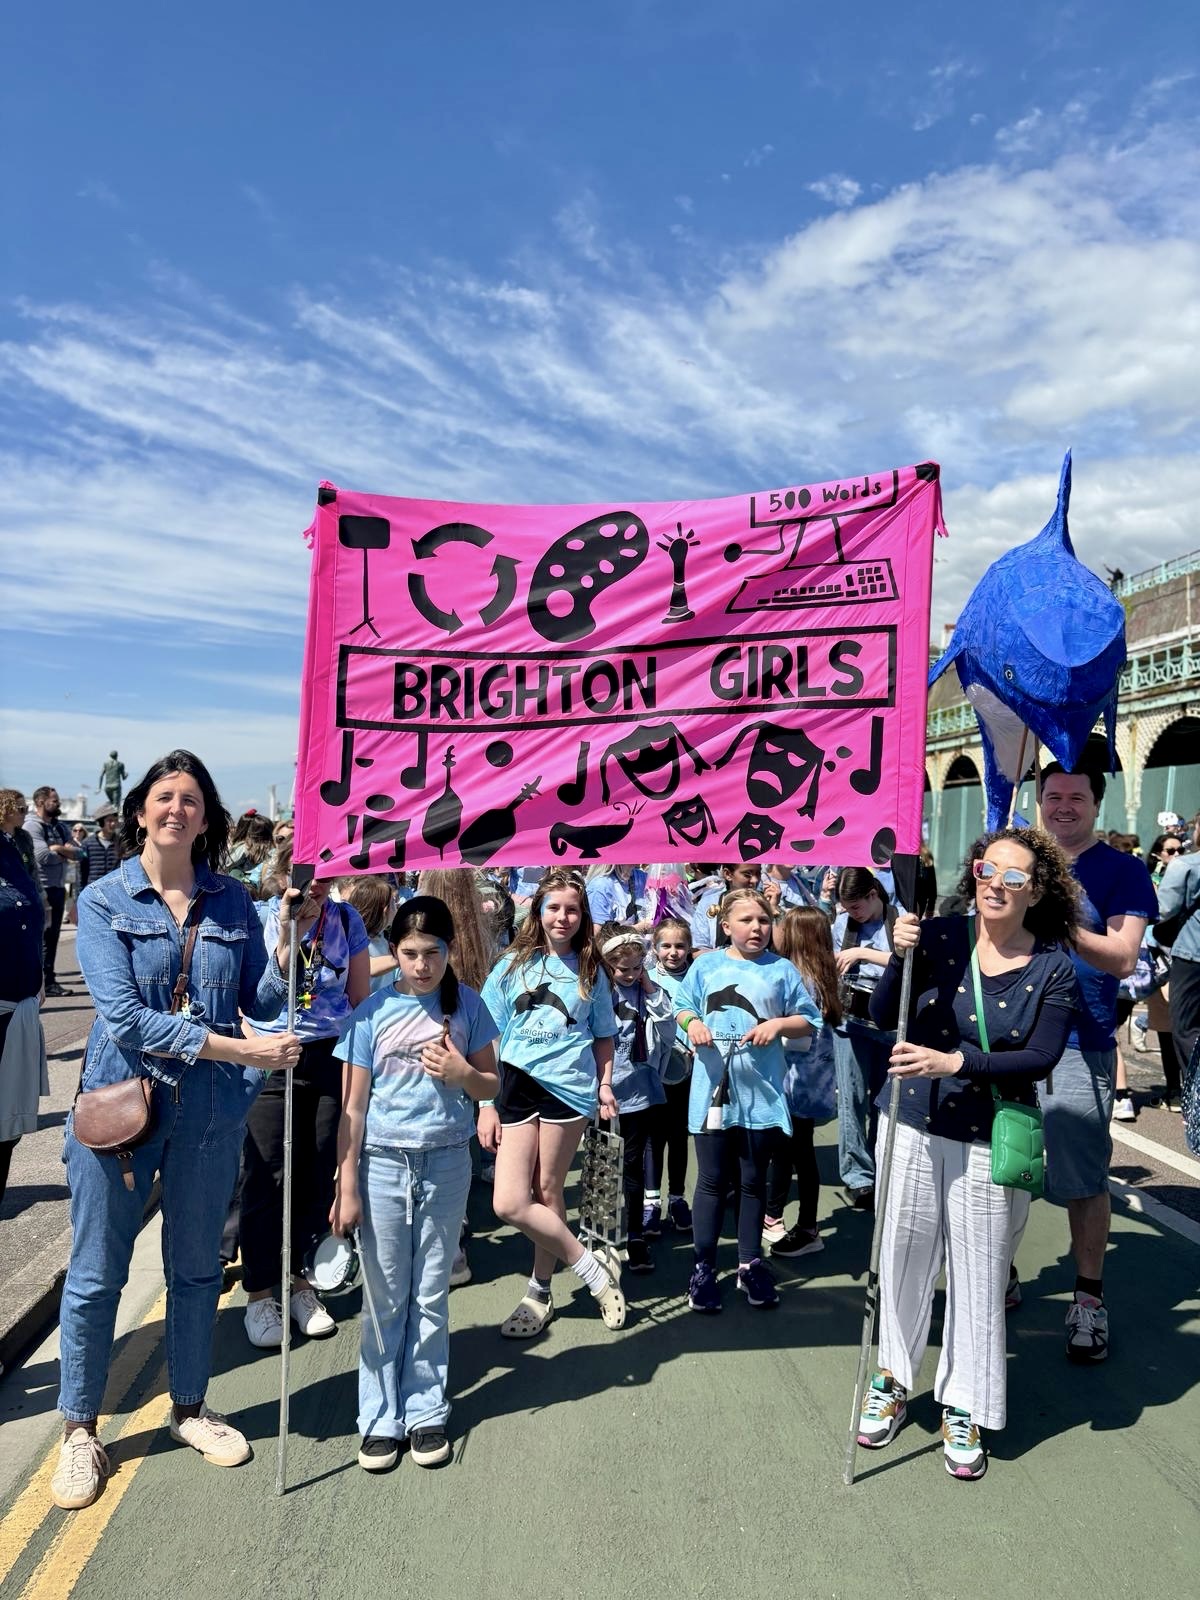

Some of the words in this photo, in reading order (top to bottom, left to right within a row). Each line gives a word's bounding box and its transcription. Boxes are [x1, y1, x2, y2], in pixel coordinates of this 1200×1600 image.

[769, 488, 812, 512] 500
[822, 477, 882, 503] Words
[393, 656, 657, 720] BRIGHTON
[709, 640, 864, 701] GIRLS
[520, 1028, 559, 1039] BRIGHTON
